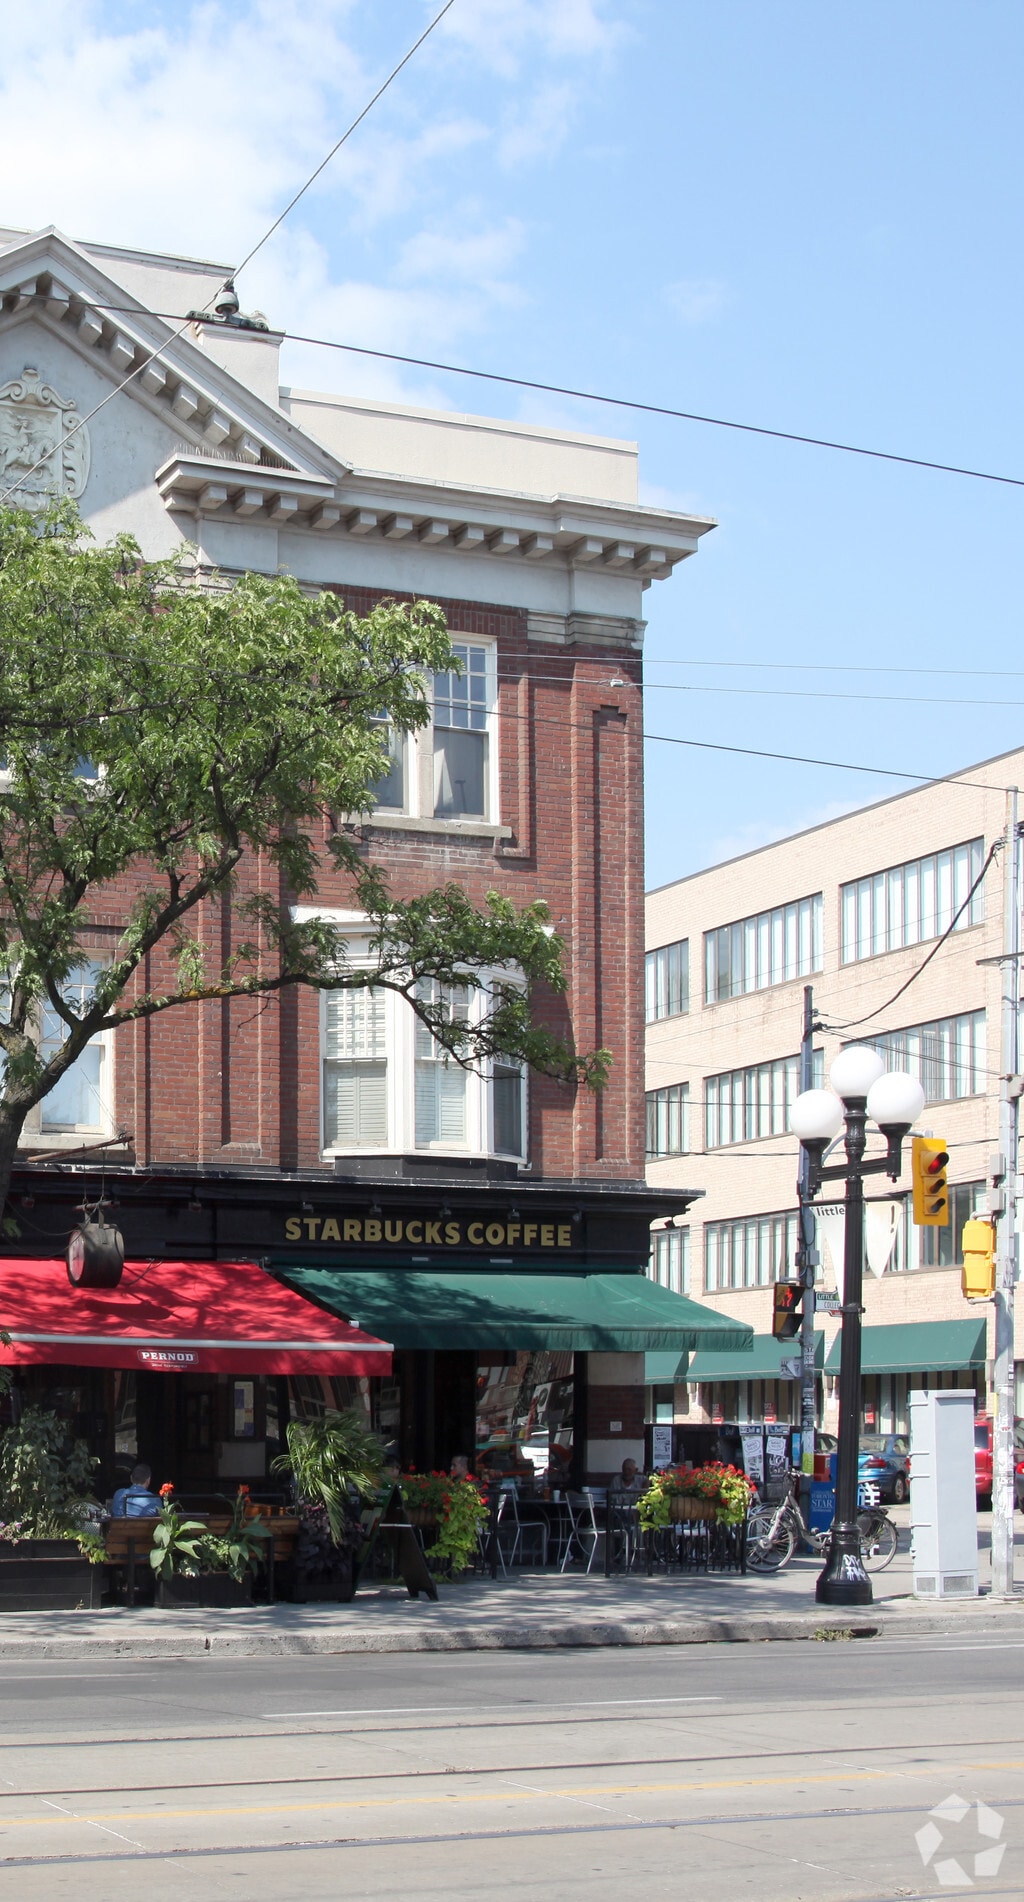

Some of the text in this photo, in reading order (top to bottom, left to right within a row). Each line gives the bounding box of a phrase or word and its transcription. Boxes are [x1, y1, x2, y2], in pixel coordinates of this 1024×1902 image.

[816, 1206, 845, 1216] little
[285, 1217, 573, 1247] STARBUCKS COFFEE
[824, 1301, 842, 1309] COLLEG
[141, 1351, 195, 1361] PERNOD
[811, 1499, 833, 1509] STAR
